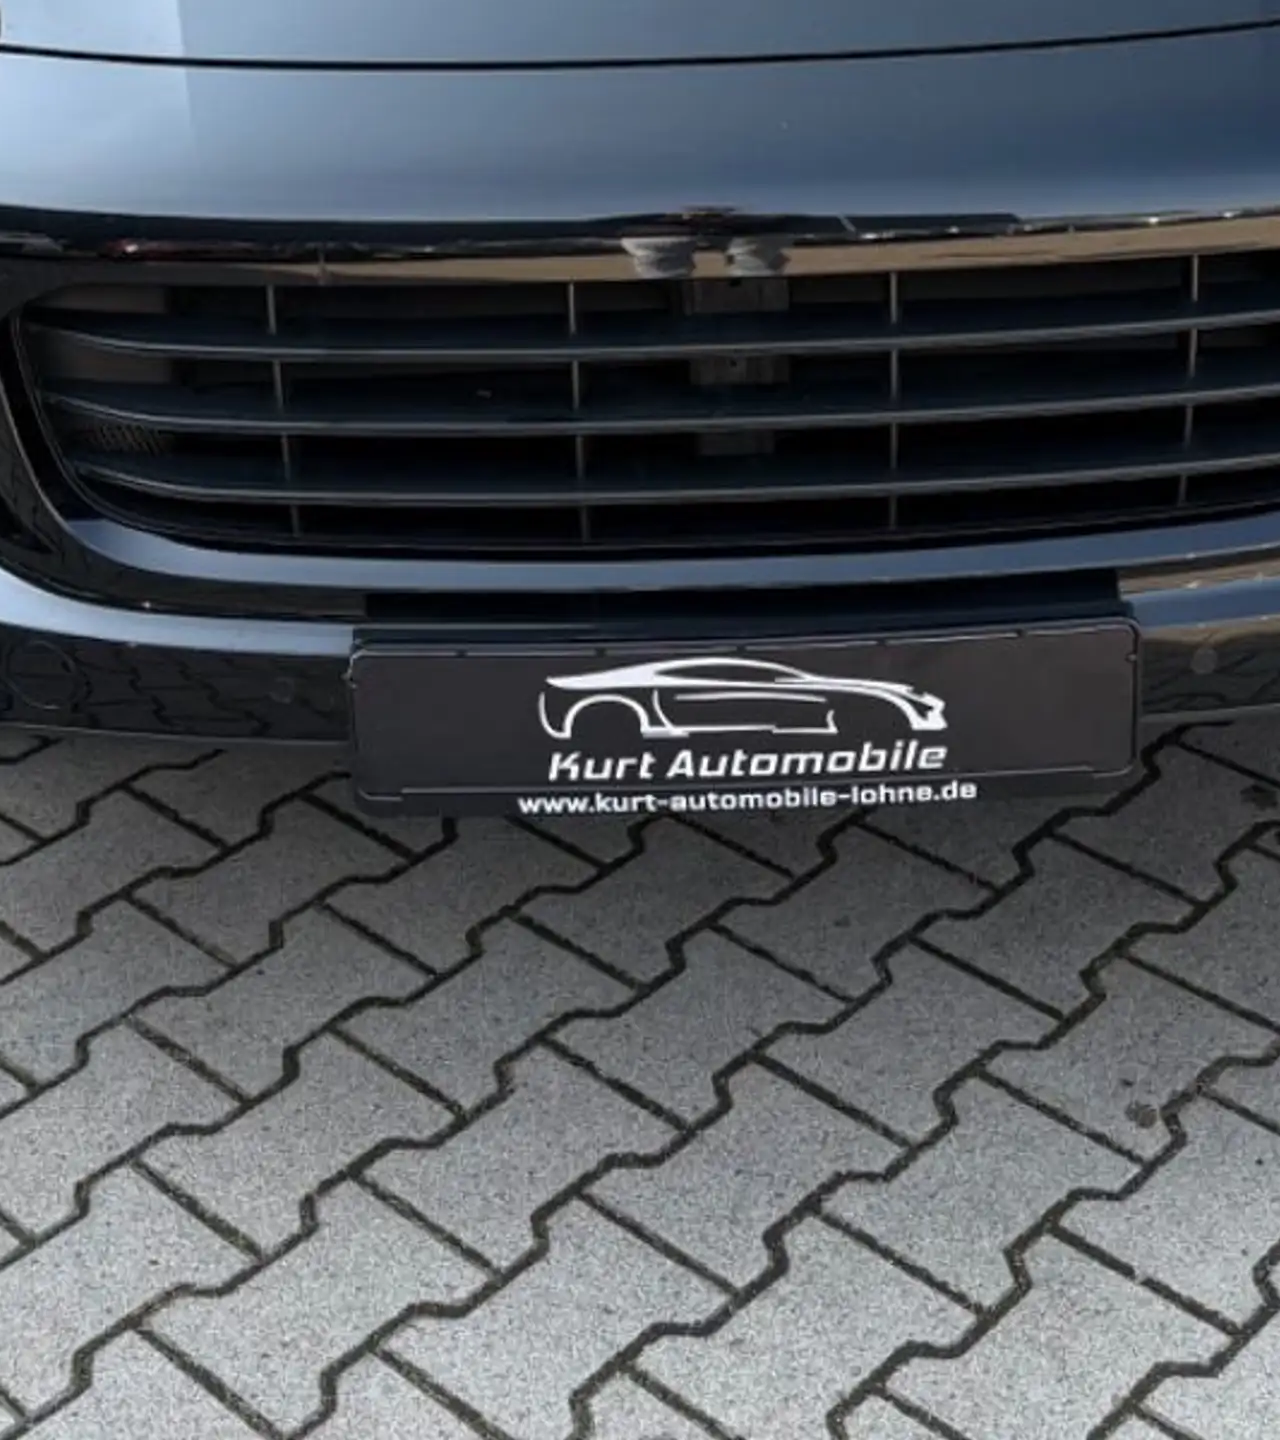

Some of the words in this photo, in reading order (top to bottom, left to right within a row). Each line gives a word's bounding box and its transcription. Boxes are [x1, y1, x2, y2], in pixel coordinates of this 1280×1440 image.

[549, 751, 656, 781] Kurt
[666, 740, 948, 779] Automobile
[518, 781, 978, 814] www.kurt-automobile-lohne.de
